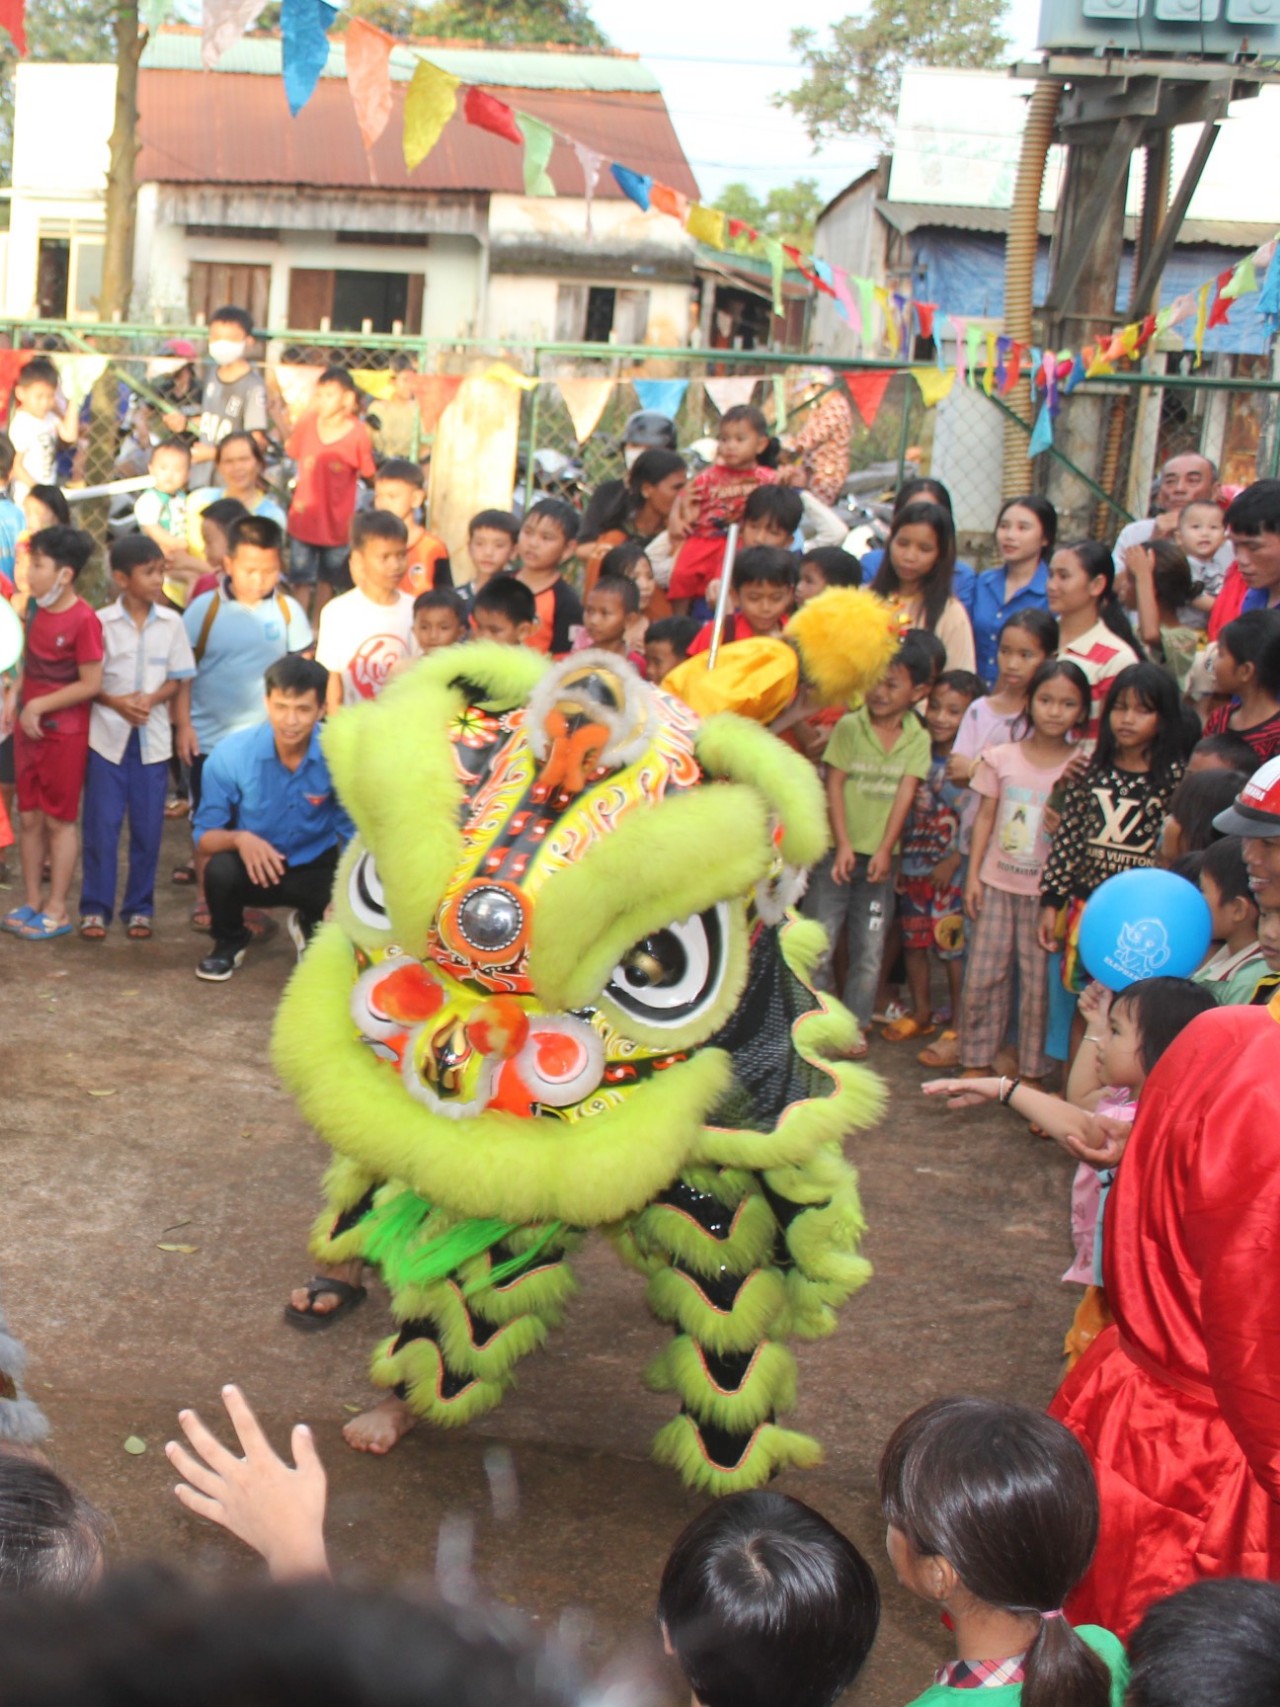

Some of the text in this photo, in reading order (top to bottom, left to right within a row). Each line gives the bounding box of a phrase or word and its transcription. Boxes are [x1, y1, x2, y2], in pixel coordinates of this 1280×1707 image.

[1086, 847, 1155, 867] UIS VUITTON
[1103, 955, 1142, 981] ELEPHAN
